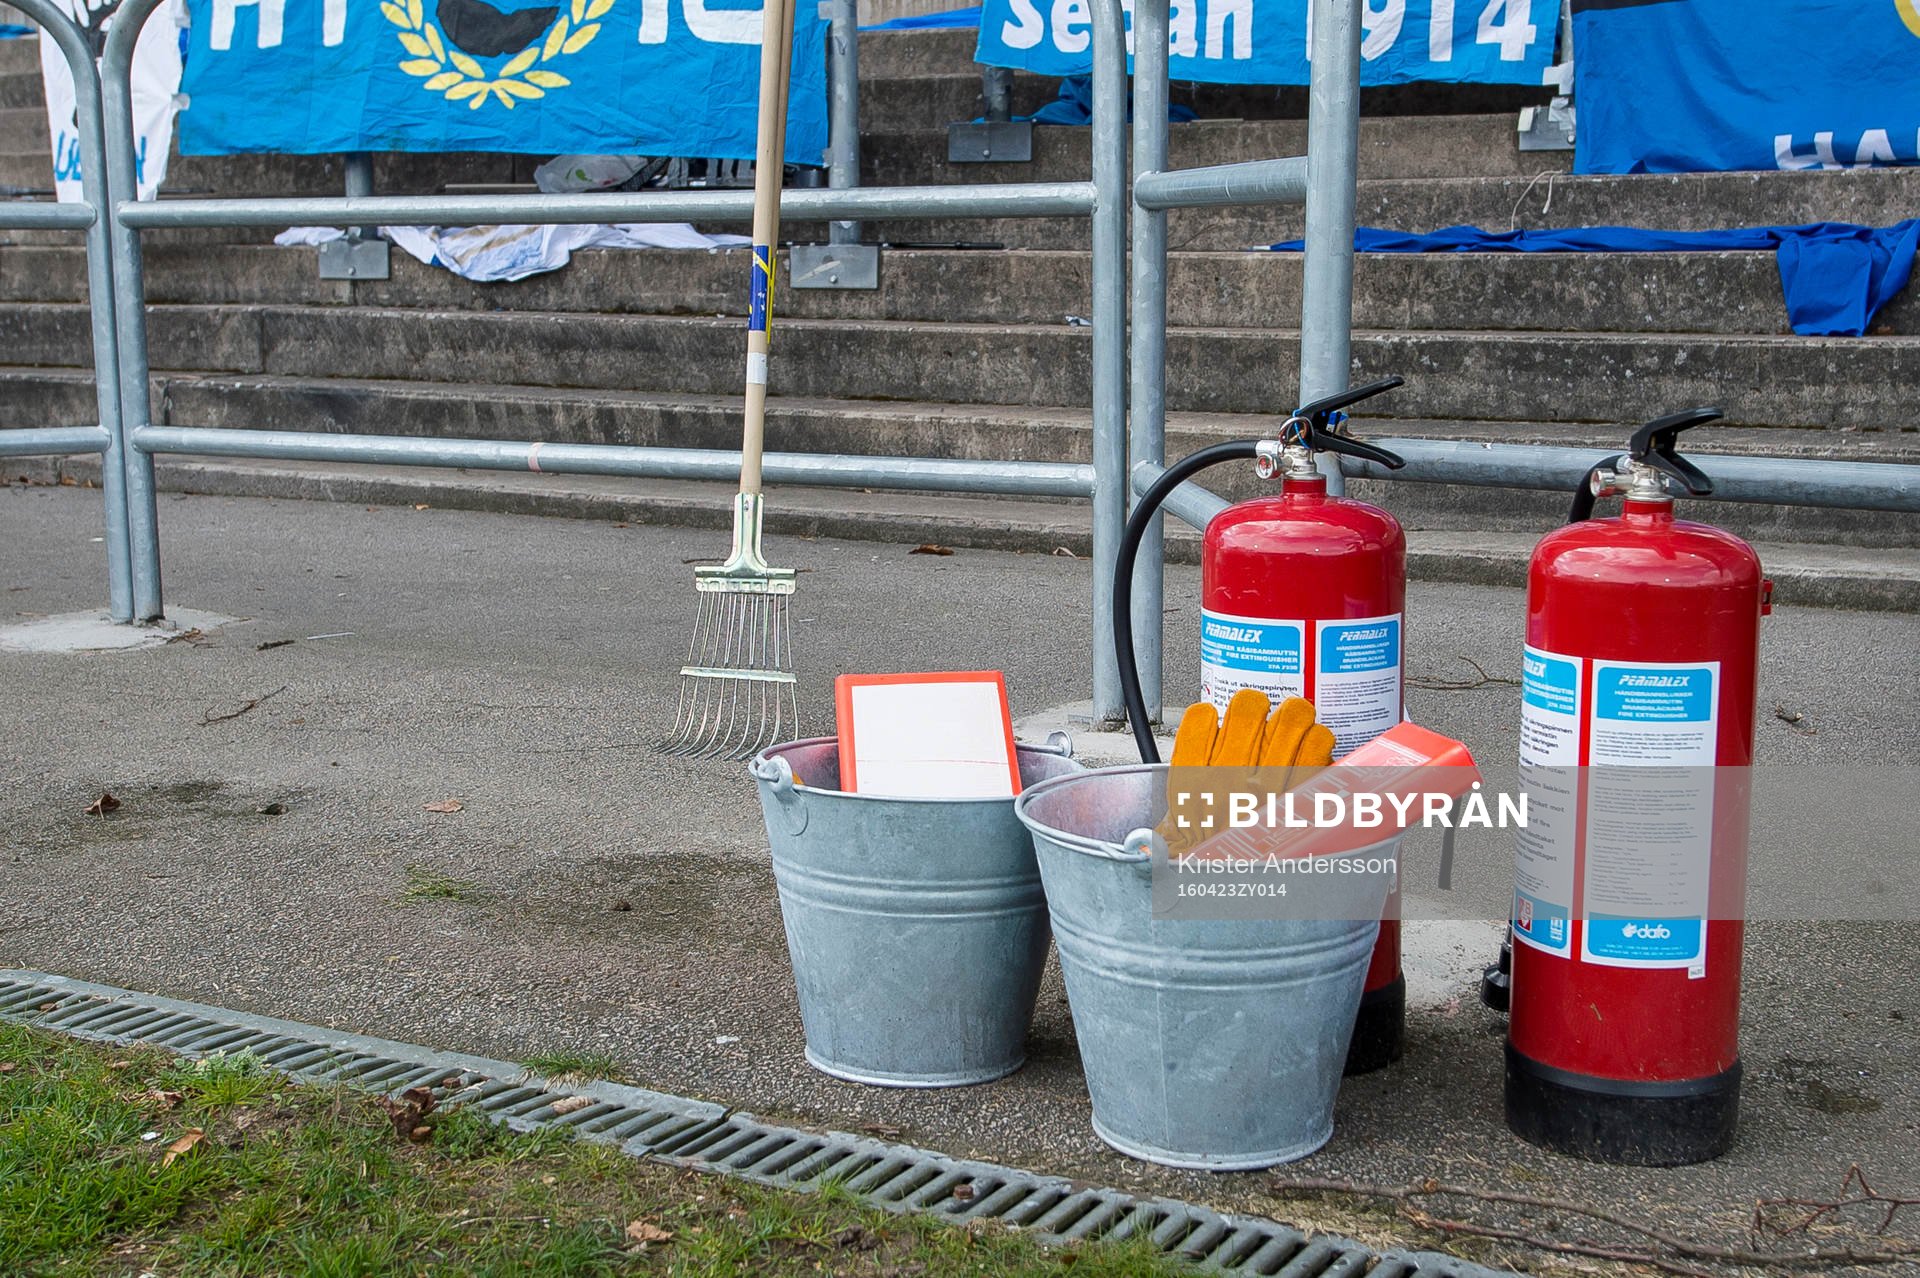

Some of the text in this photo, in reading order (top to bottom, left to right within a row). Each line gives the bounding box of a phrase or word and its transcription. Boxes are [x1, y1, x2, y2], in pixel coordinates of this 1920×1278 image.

[1001, 0, 1537, 62] Sean 914
[1774, 127, 1920, 170] HA
[1205, 622, 1263, 643] PERMALEX
[1340, 628, 1389, 642] PERMALEX
[1618, 675, 1690, 687] PERMALEX
[1636, 923, 1671, 939] dafo
